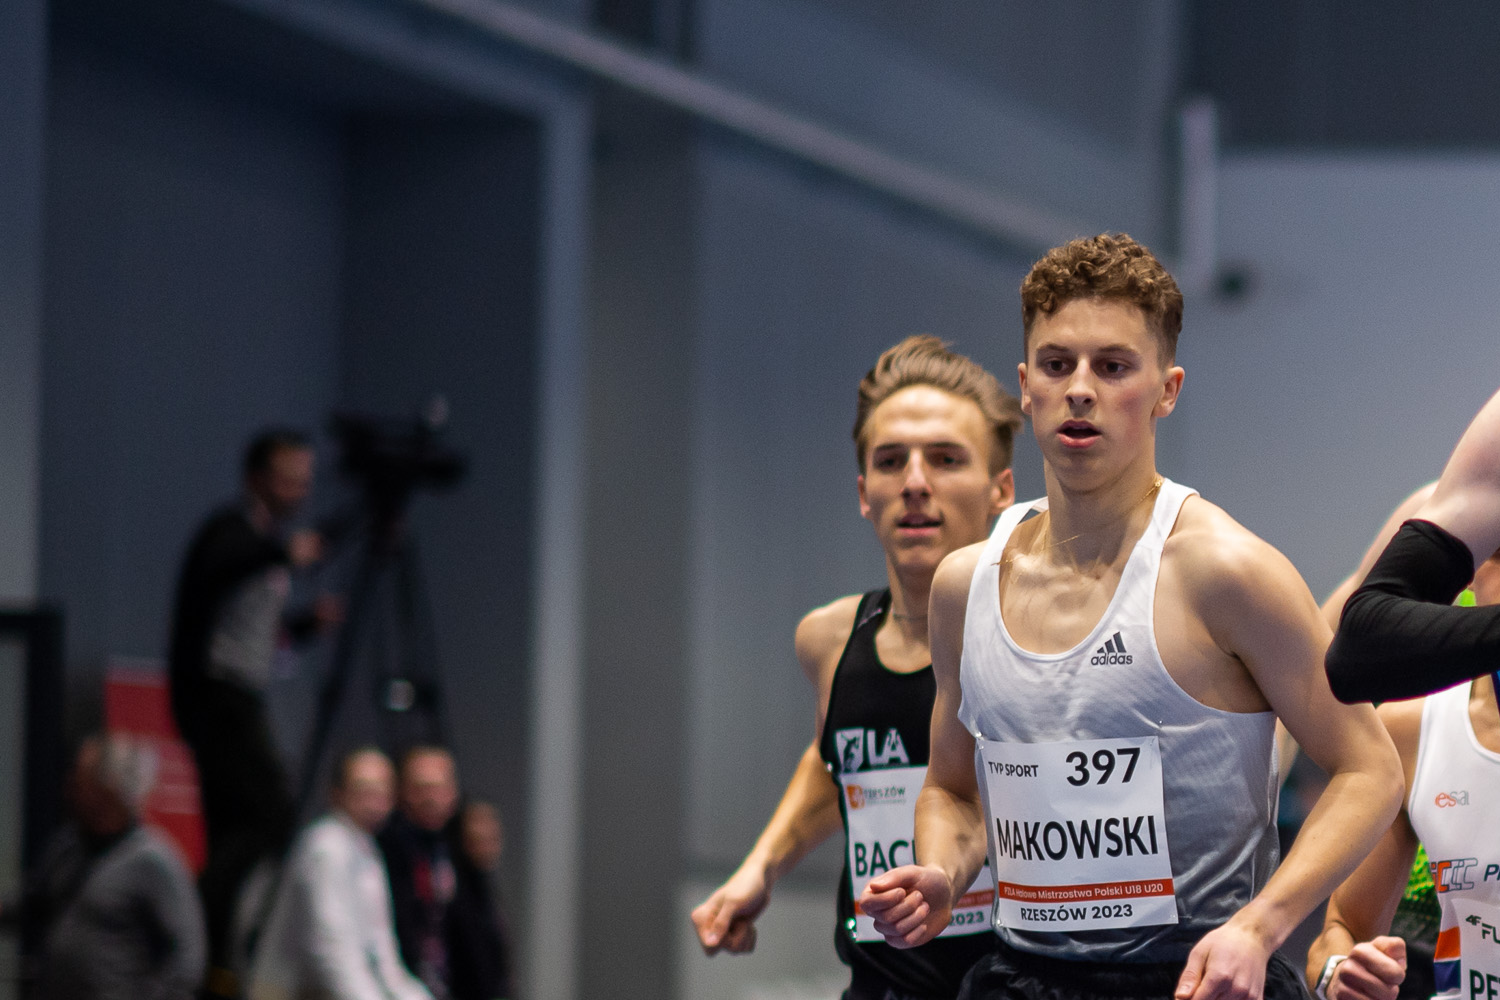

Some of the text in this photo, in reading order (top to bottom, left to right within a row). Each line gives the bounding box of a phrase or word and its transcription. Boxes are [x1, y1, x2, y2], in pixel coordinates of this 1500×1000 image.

[1090, 652, 1133, 666] adidas
[988, 761, 1039, 777] TVP SPORT
[1065, 747, 1141, 787] 397
[1434, 790, 1470, 809] esa
[996, 815, 1159, 861] MAKOWSKI
[1038, 888, 1092, 900] Mistrzostwa
[1094, 885, 1123, 897] Polski
[1125, 884, 1142, 895] U18
[1144, 883, 1164, 894] U20
[1020, 904, 1133, 922] RZESZÓW 2023
